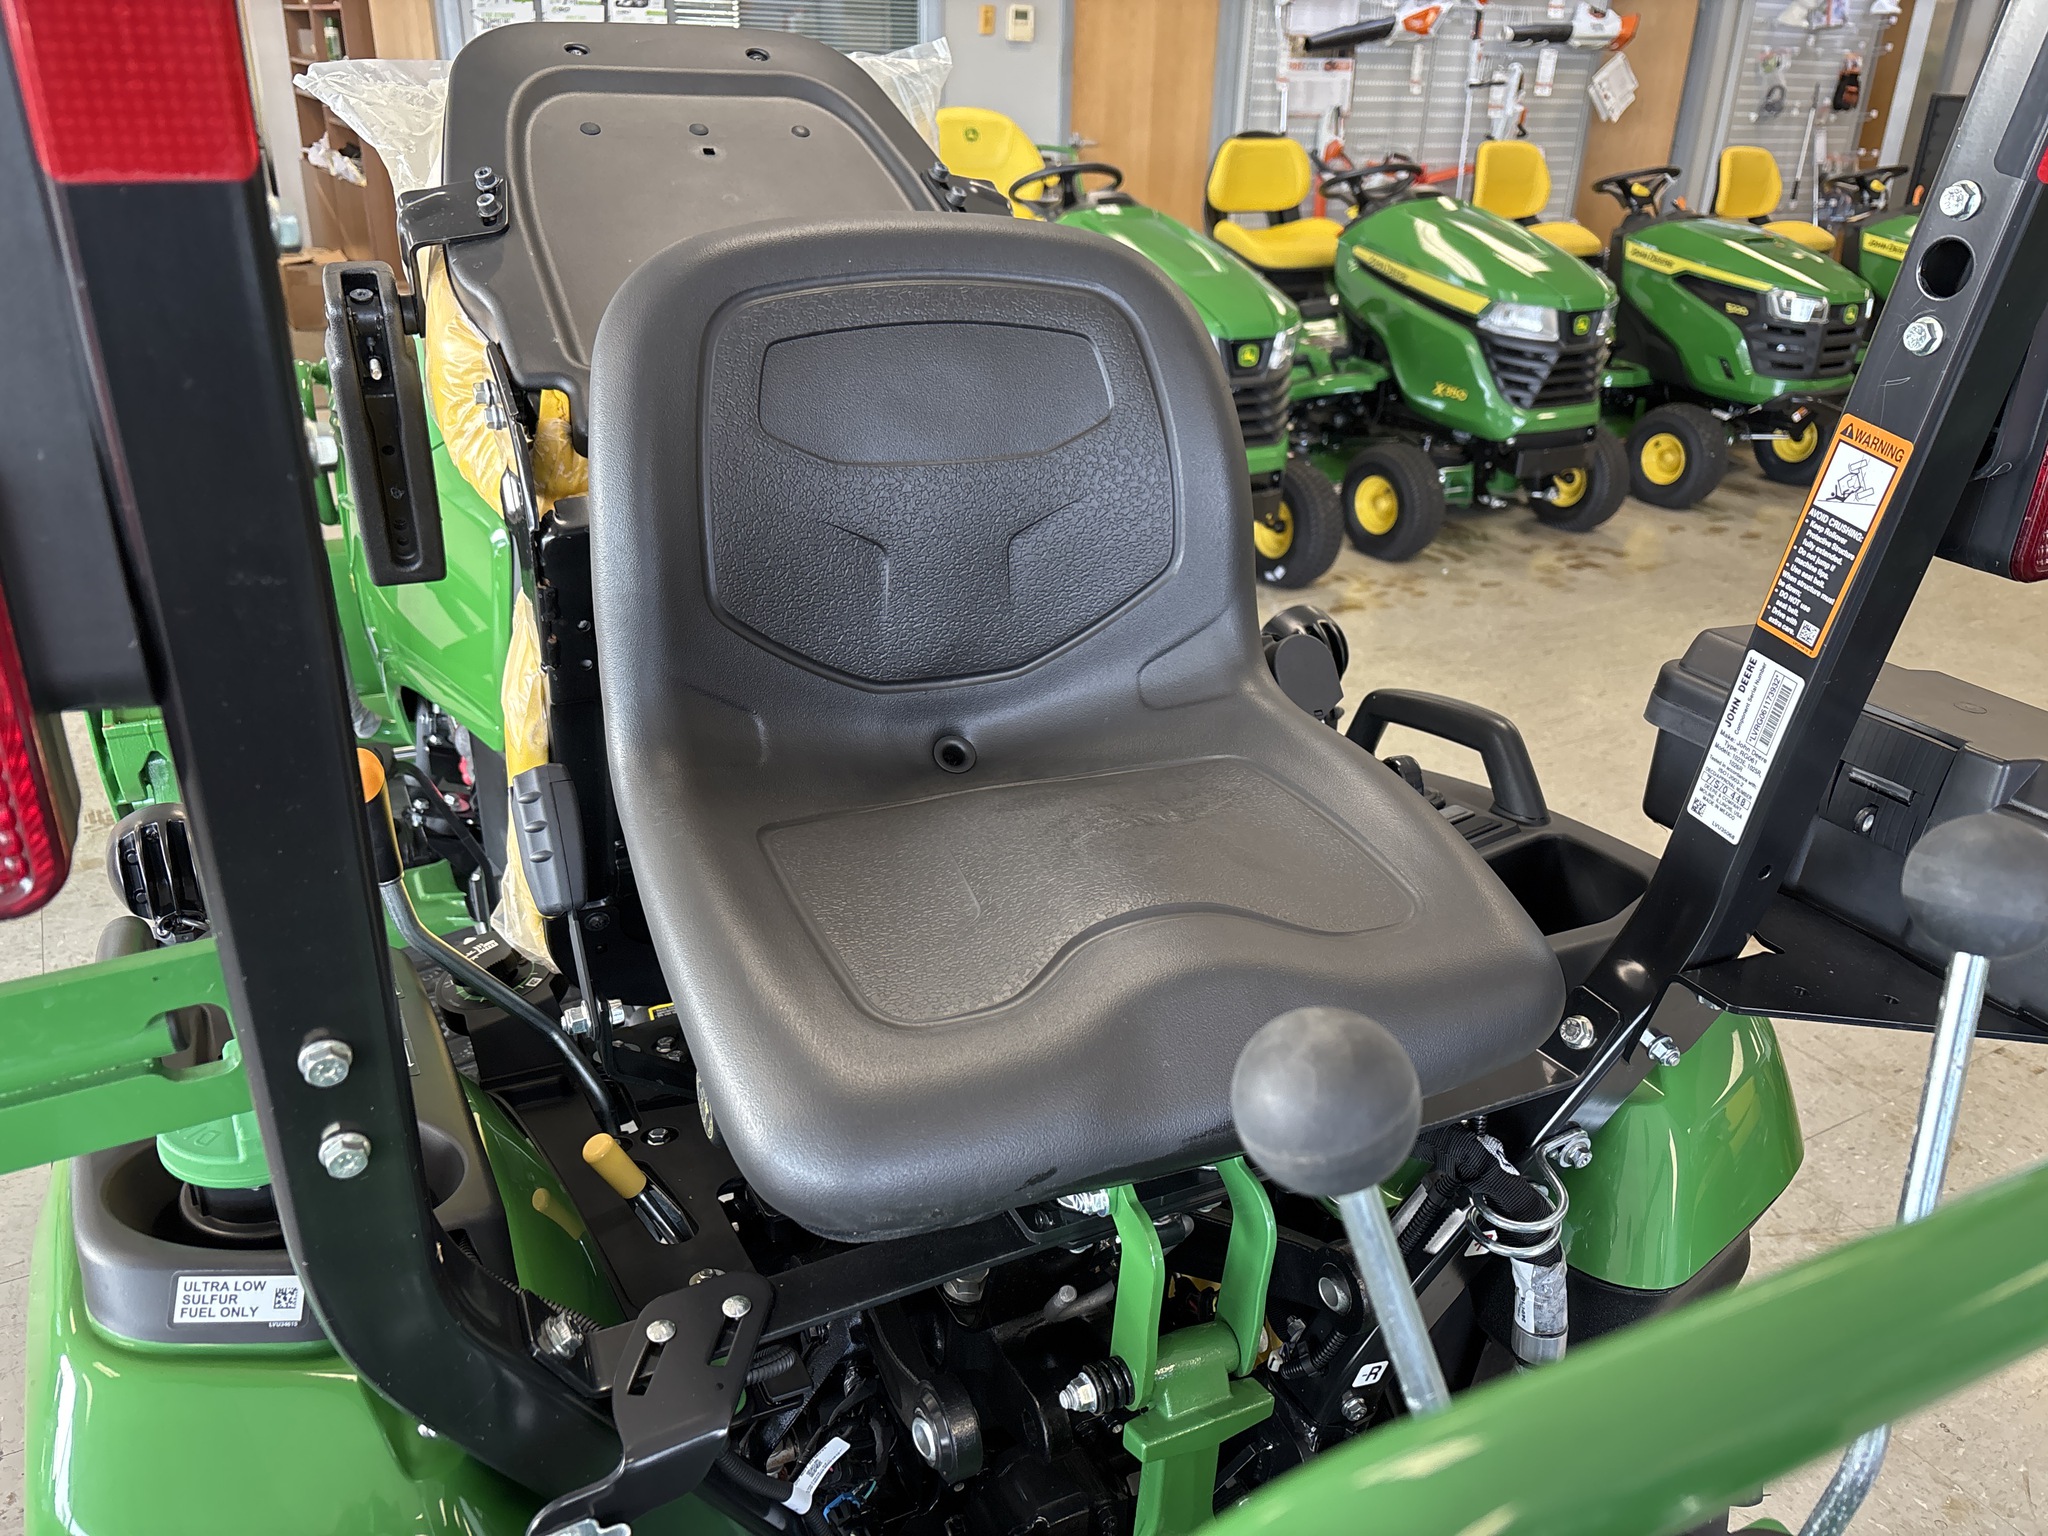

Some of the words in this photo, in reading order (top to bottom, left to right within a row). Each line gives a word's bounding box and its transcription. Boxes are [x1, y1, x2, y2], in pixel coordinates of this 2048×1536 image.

[1852, 428, 1905, 463] WARNING
[1808, 506, 1829, 524] AVOID
[1827, 516, 1865, 542] CRUSHING:
[1808, 519, 1825, 534] Keep
[1823, 526, 1848, 545] Rollover
[1801, 537, 1816, 551] fully
[1814, 544, 1844, 565] extended.
[1805, 528, 1832, 548] Protective
[1830, 541, 1856, 561] Structure
[1794, 554, 1818, 573] machine
[1816, 567, 1830, 581] tips.
[1797, 546, 1807, 556] Do
[1805, 550, 1817, 561] not
[1814, 556, 1831, 571] jump
[1829, 563, 1836, 572] if
[1777, 578, 1786, 588] be
[1781, 569, 1797, 583] When
[1796, 578, 1822, 597] structure
[1820, 592, 1835, 605] must
[1789, 563, 1802, 575] Use
[1800, 569, 1814, 582] seat
[1812, 576, 1826, 588] belt.
[1775, 598, 1788, 610] seat
[1786, 605, 1800, 617] belt.
[1778, 589, 1788, 600] DO
[1787, 594, 1801, 606] NOT
[1799, 602, 1811, 613] use
[1767, 614, 1782, 627] extra
[1781, 623, 1795, 635] care.
[1771, 606, 1786, 619] Drive
[1784, 614, 1798, 626] with
[1723, 696, 1741, 728] JOHN
[1737, 656, 1757, 693] DEERE
[1733, 702, 1751, 736] Component
[1746, 684, 1757, 703] Serial
[1754, 661, 1767, 685] Number
[1714, 741, 1732, 757] Models:
[1719, 728, 1736, 743] Make:
[1736, 739, 1751, 752] John
[1750, 749, 1768, 764] Deere
[1722, 739, 1739, 754] Type:
[1738, 749, 1758, 765] RG061
[184, 1281, 229, 1292] ULTRA
[234, 1280, 267, 1292] LOW
[180, 1307, 216, 1318] FUEL
[220, 1306, 259, 1318] ONLY
[182, 1294, 238, 1305] SULFUR
